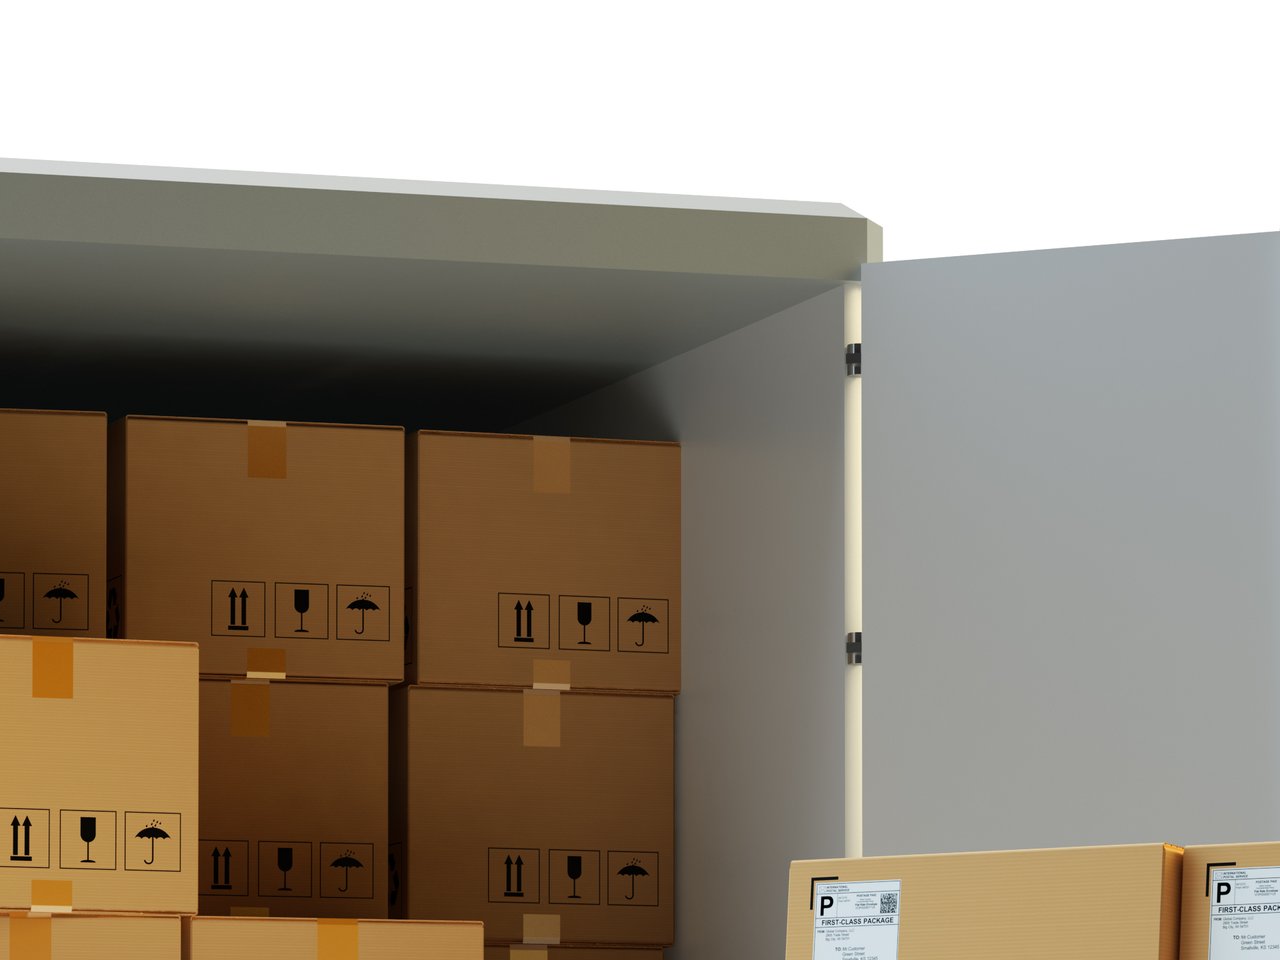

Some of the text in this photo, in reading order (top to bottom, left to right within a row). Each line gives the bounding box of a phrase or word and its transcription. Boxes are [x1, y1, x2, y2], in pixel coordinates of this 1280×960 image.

[1217, 882, 1231, 903] P
[820, 896, 834, 916] P
[1218, 905, 1261, 913] FIRST-CLASS
[821, 918, 862, 926] FIRST-CLASS
